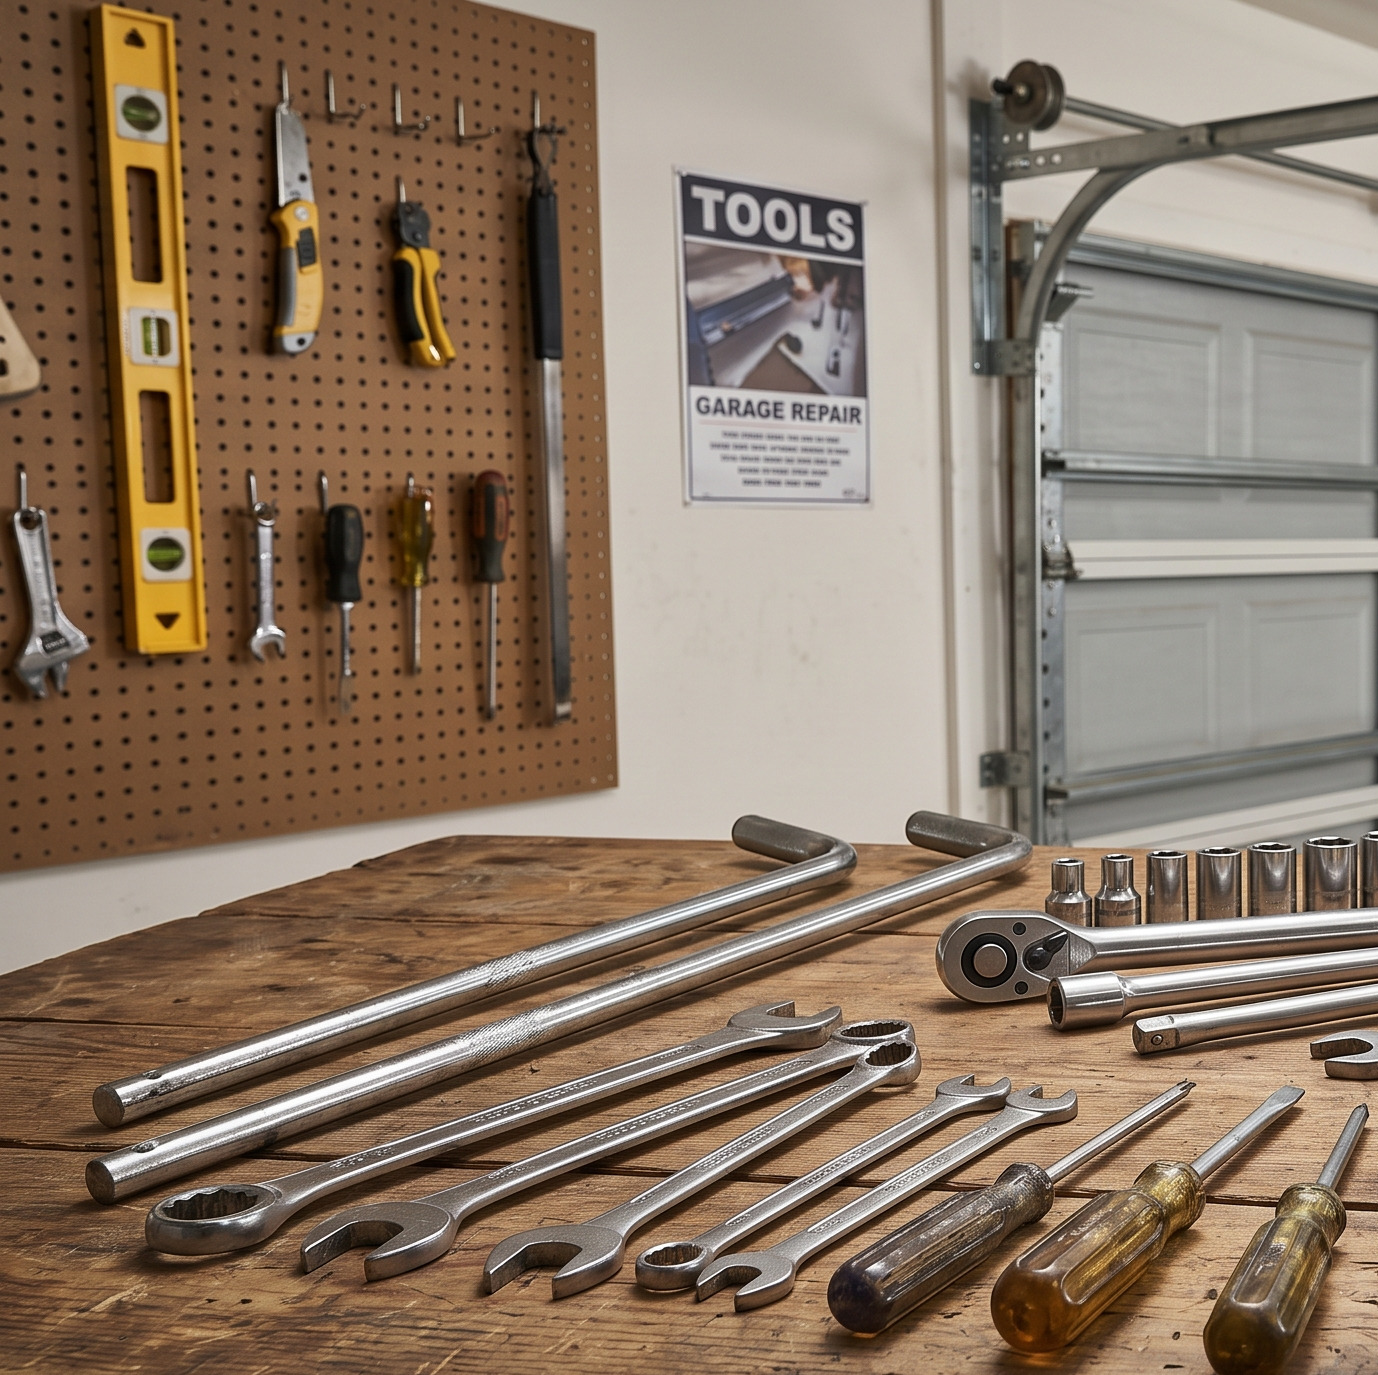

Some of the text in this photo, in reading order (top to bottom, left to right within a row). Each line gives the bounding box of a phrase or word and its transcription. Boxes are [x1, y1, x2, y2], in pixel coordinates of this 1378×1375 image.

[691, 184, 855, 252] TOOLS
[696, 396, 862, 425] GARAGE REPAIR
